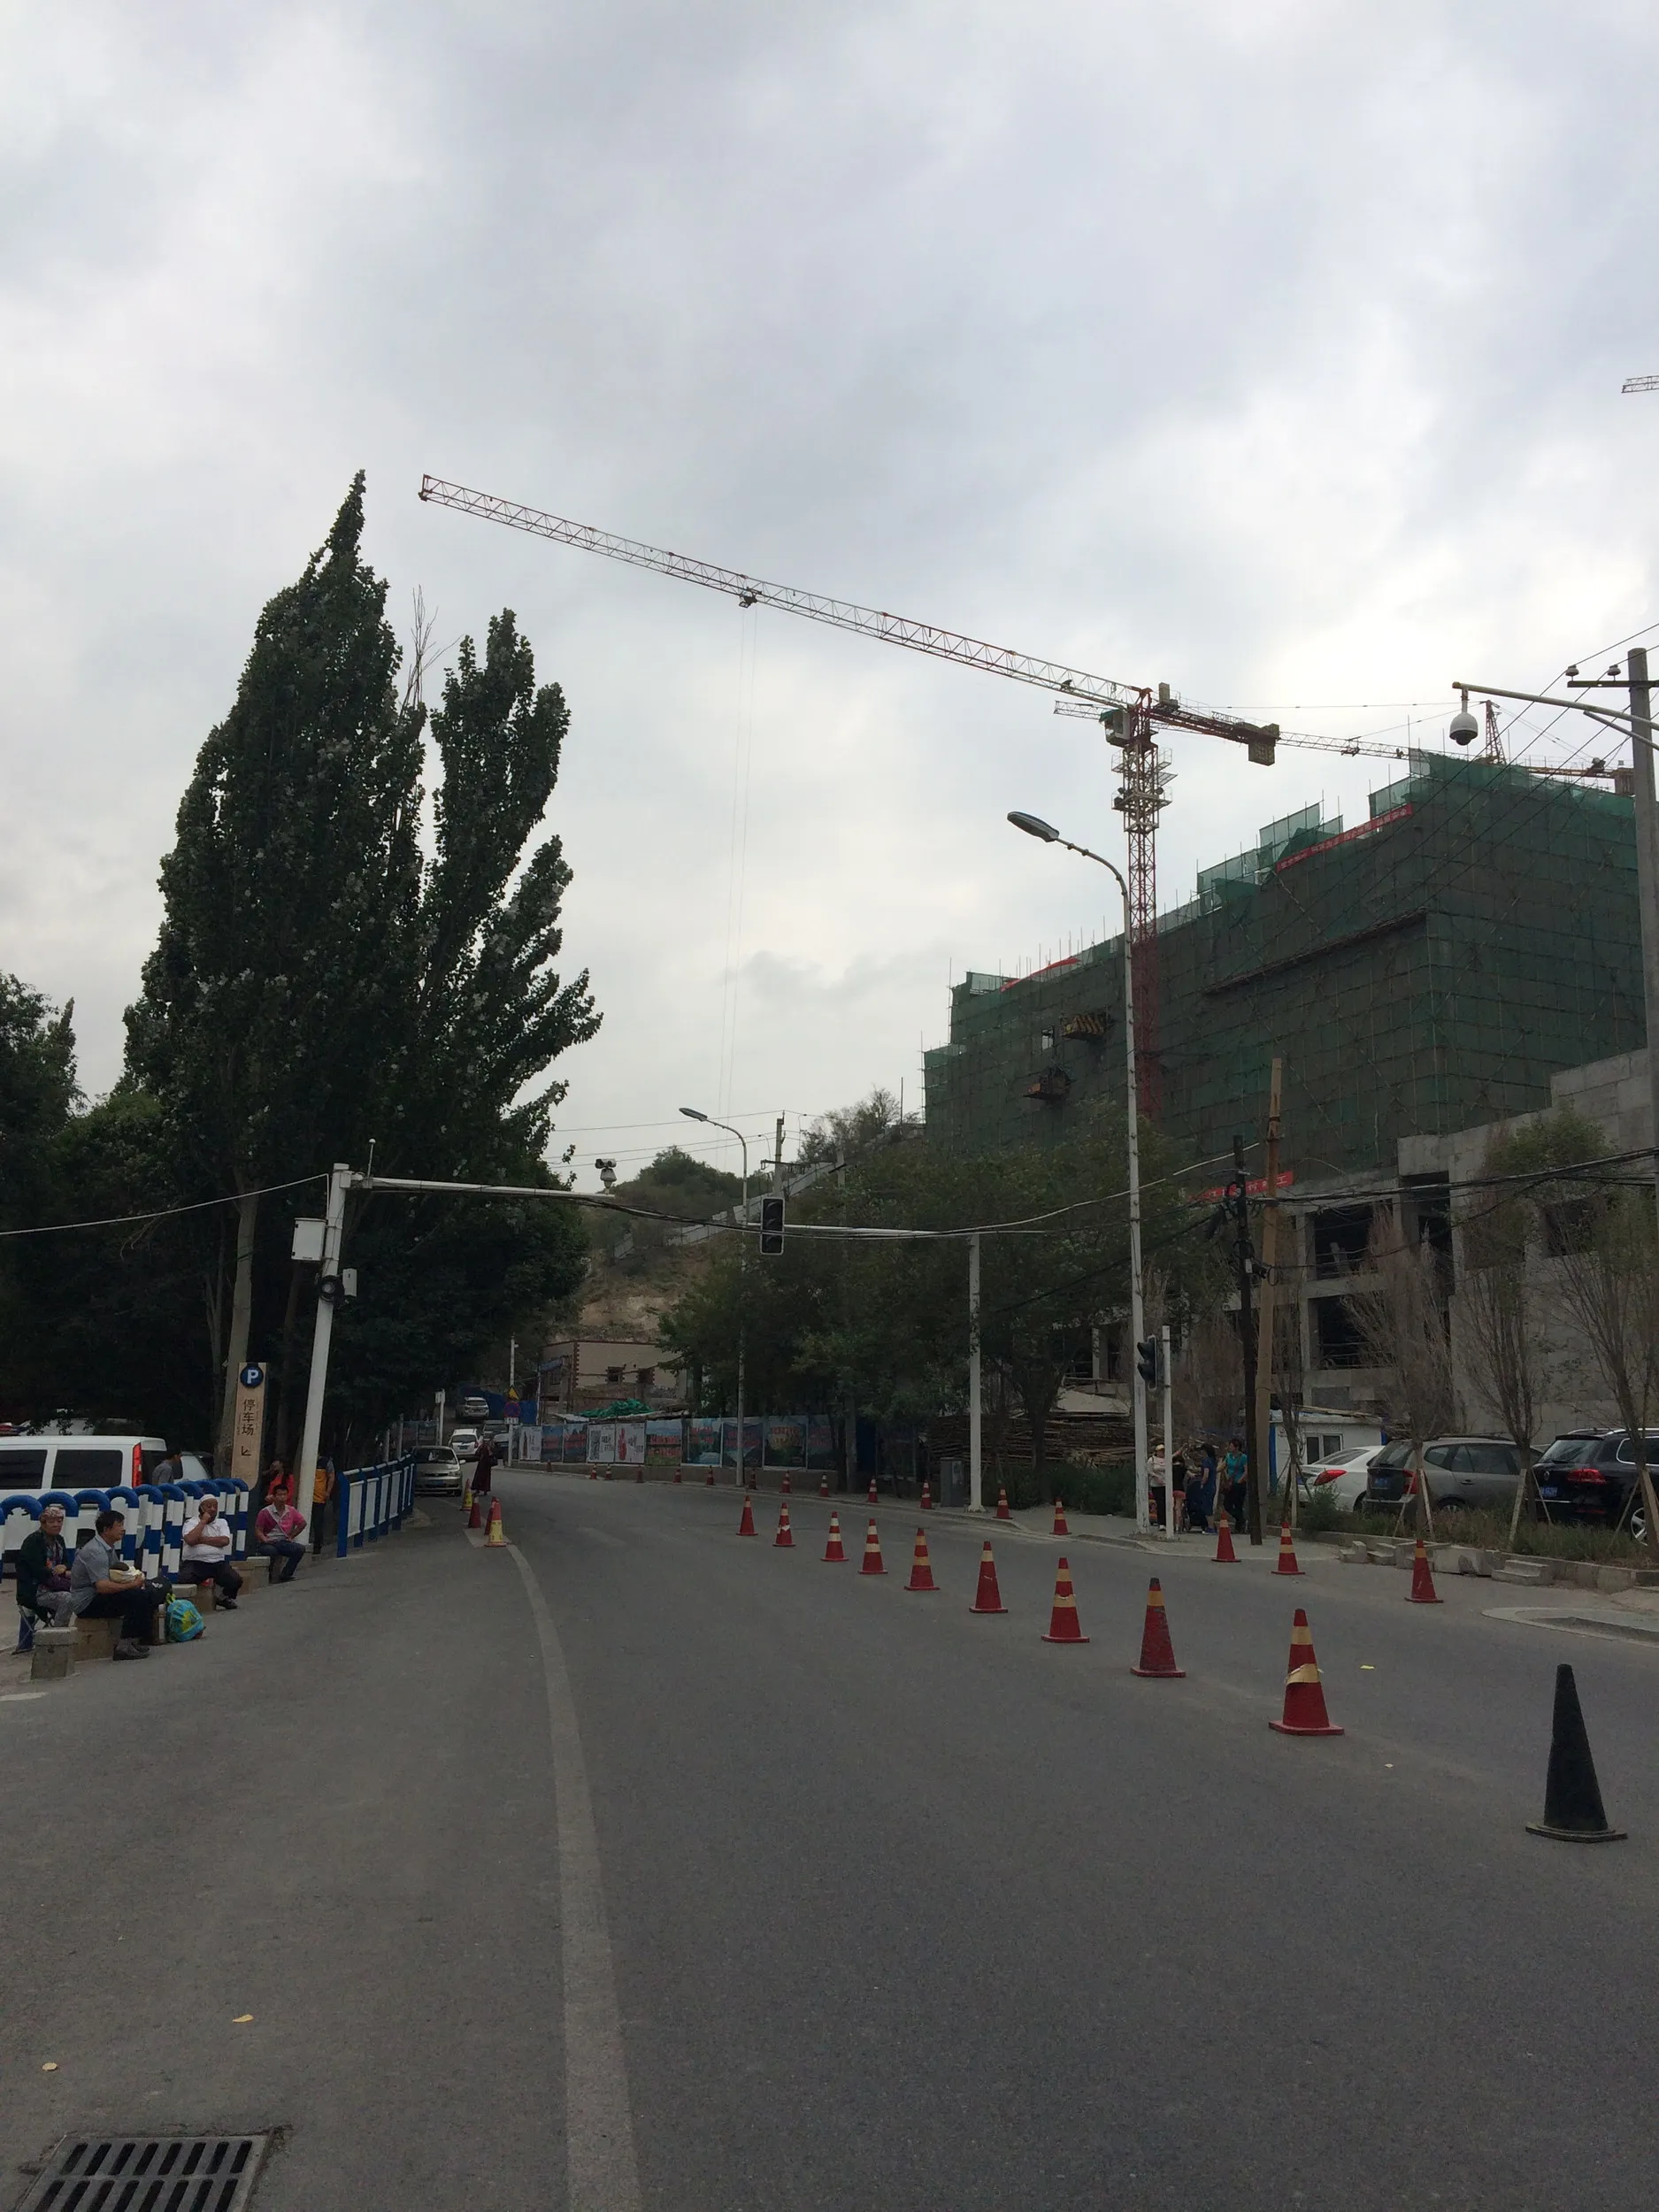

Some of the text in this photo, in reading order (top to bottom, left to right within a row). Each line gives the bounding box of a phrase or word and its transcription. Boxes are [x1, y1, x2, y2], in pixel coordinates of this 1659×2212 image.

[247, 1369, 258, 1384] P
[241, 1398, 256, 1436] 停车场
